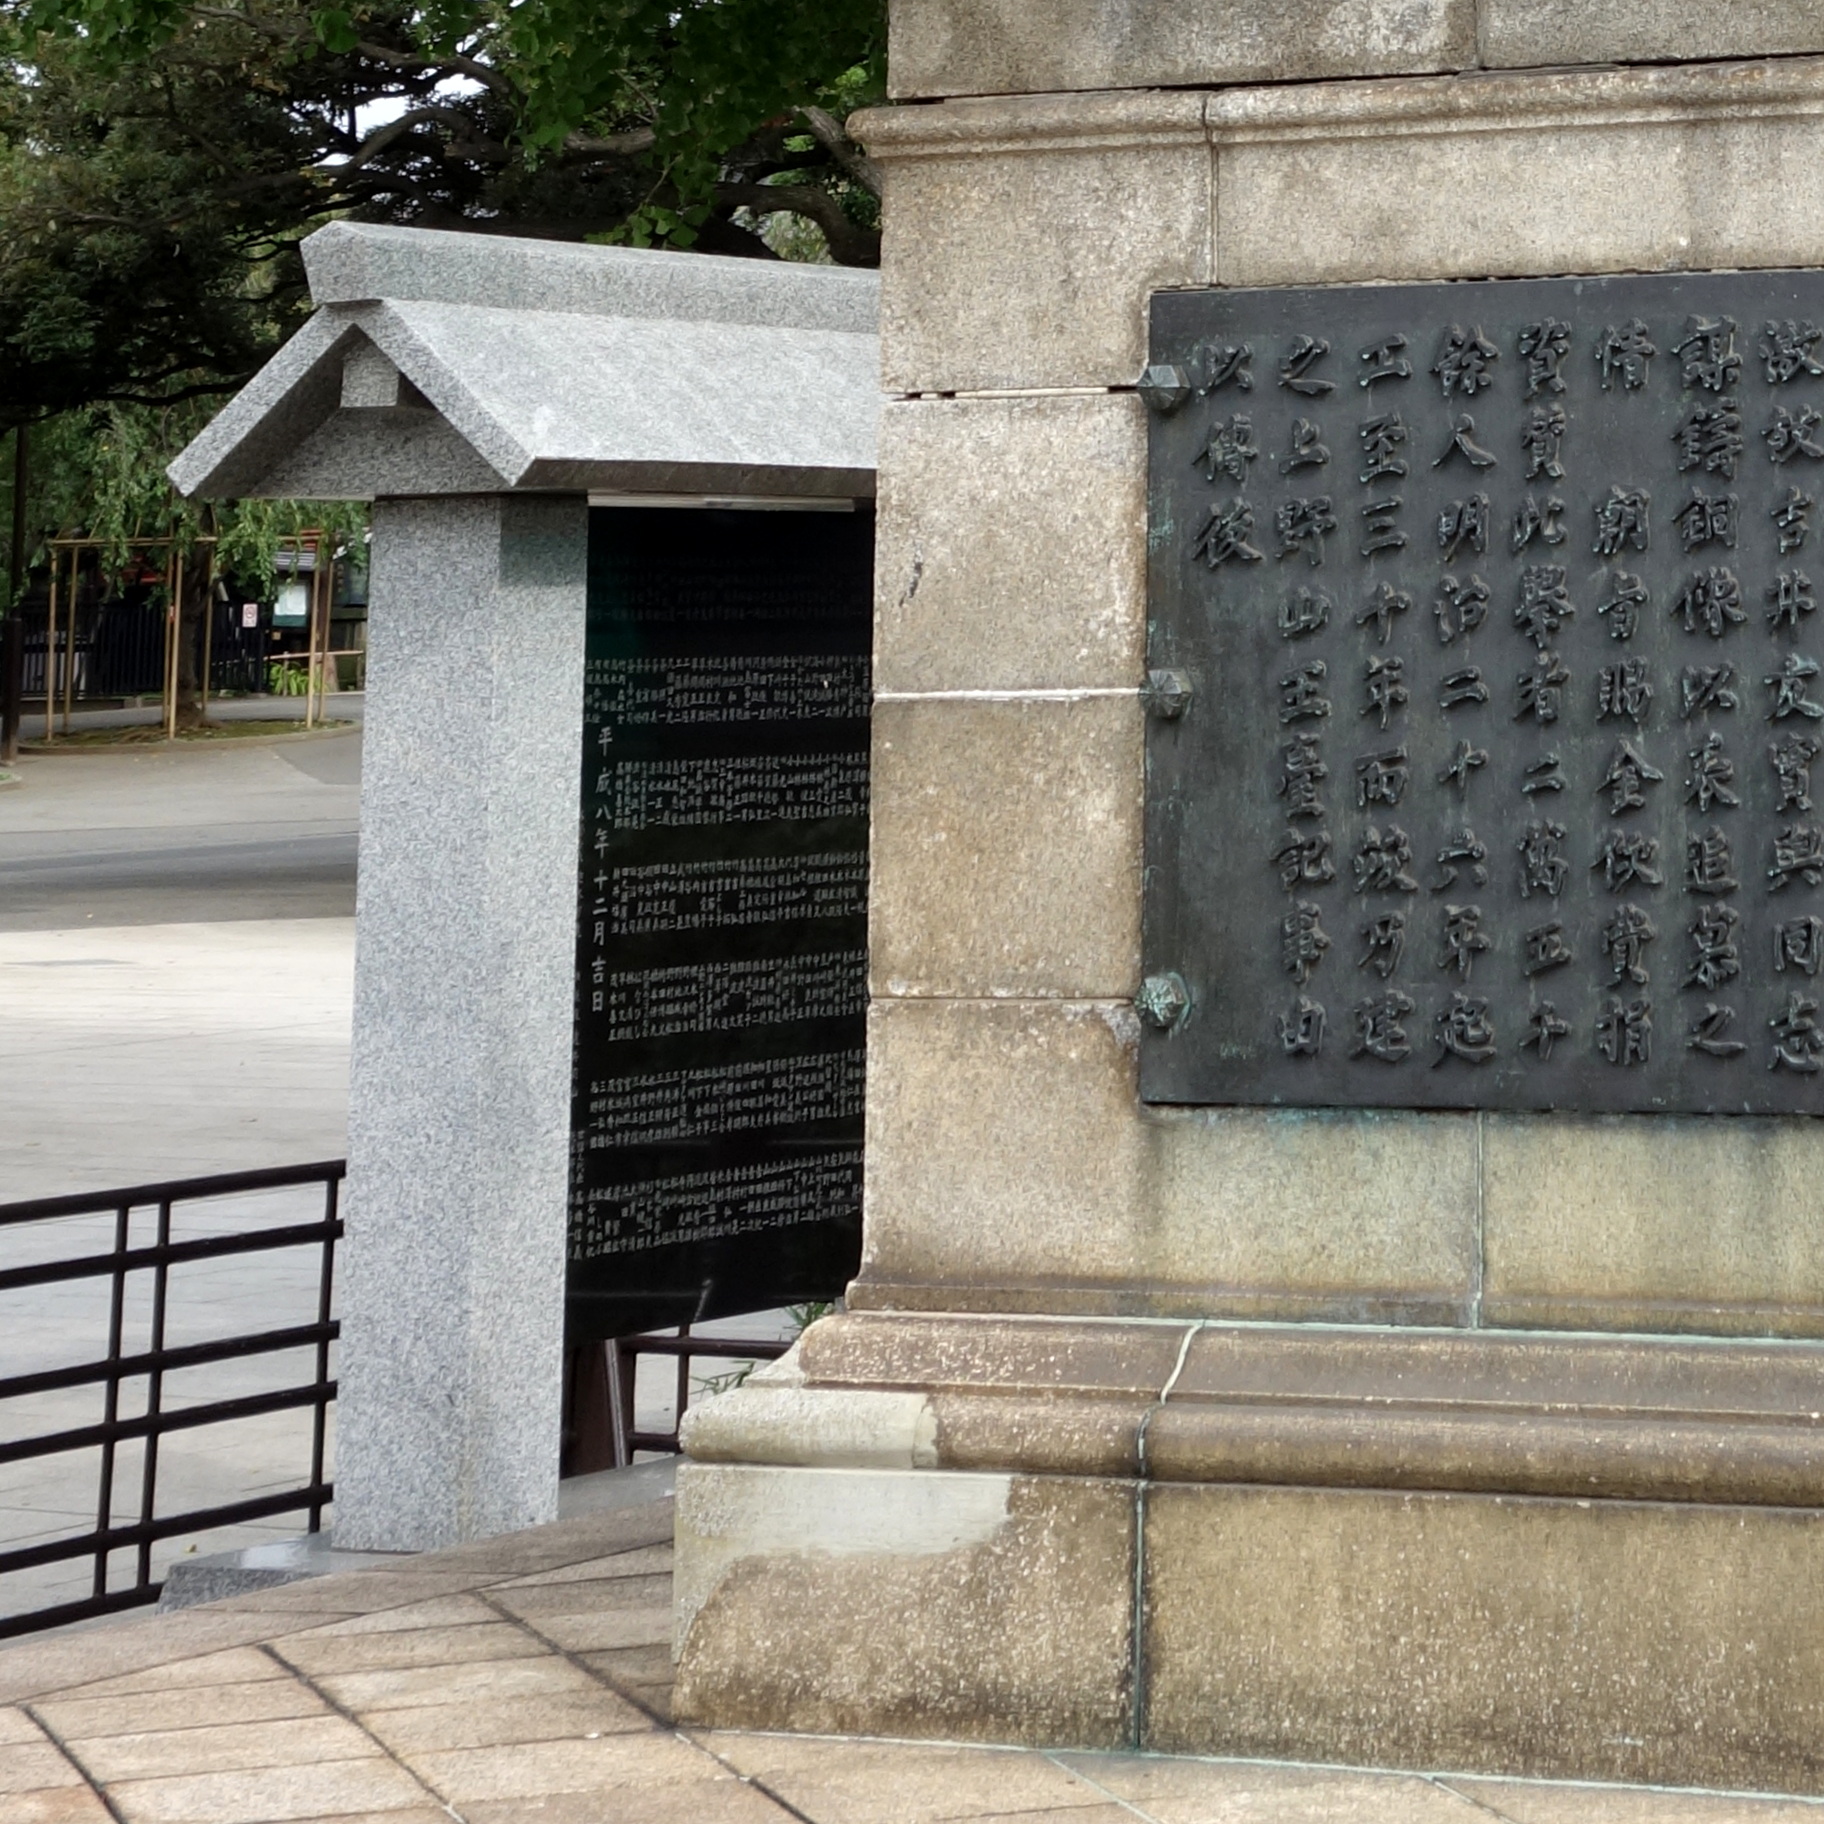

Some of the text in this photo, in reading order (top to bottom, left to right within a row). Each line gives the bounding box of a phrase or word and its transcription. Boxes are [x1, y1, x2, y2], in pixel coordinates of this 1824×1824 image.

[592, 726, 612, 1012] 平成八年十二月吉日
